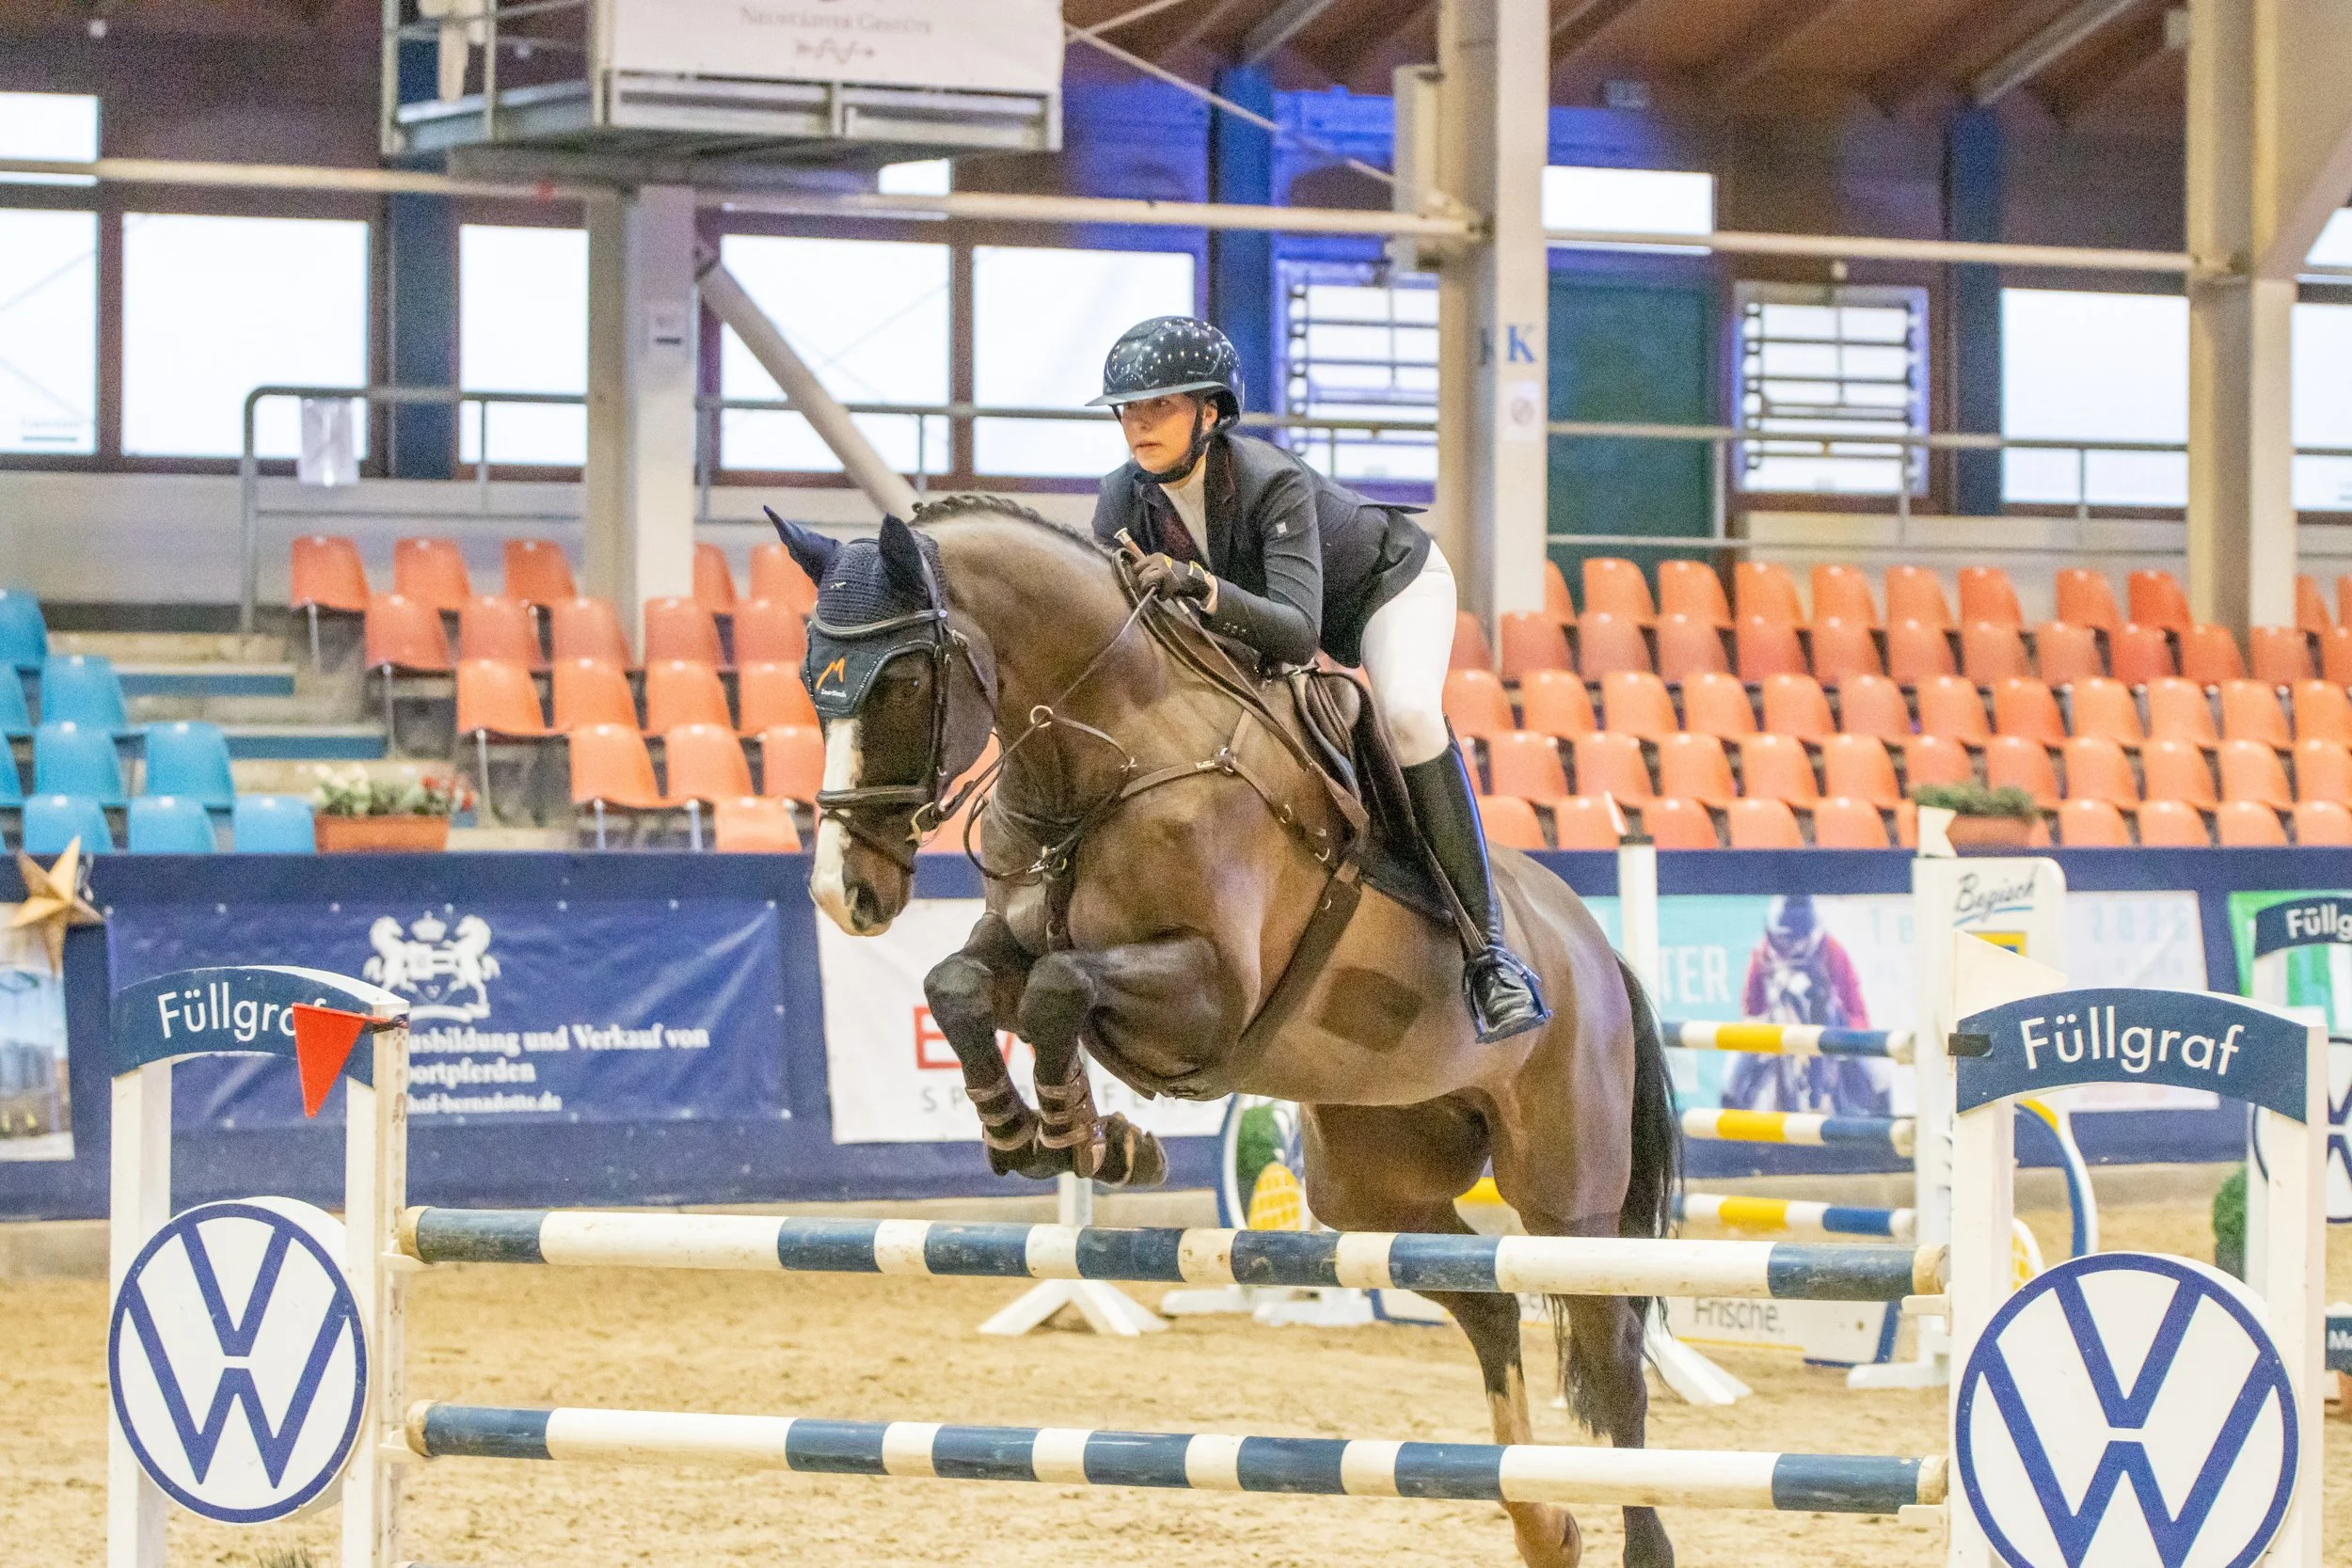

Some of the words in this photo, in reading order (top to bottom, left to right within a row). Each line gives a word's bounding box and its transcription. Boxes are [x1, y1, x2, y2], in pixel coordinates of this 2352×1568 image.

[1507, 324, 1535, 363] K
[157, 981, 327, 1042] Füllgr
[408, 1026, 521, 1057] usbildung
[523, 1023, 569, 1052] und
[571, 1022, 662, 1050] Verkauf
[664, 1028, 710, 1049] von
[2021, 1006, 2245, 1075] Füllgraf
[124, 1219, 352, 1490] VW
